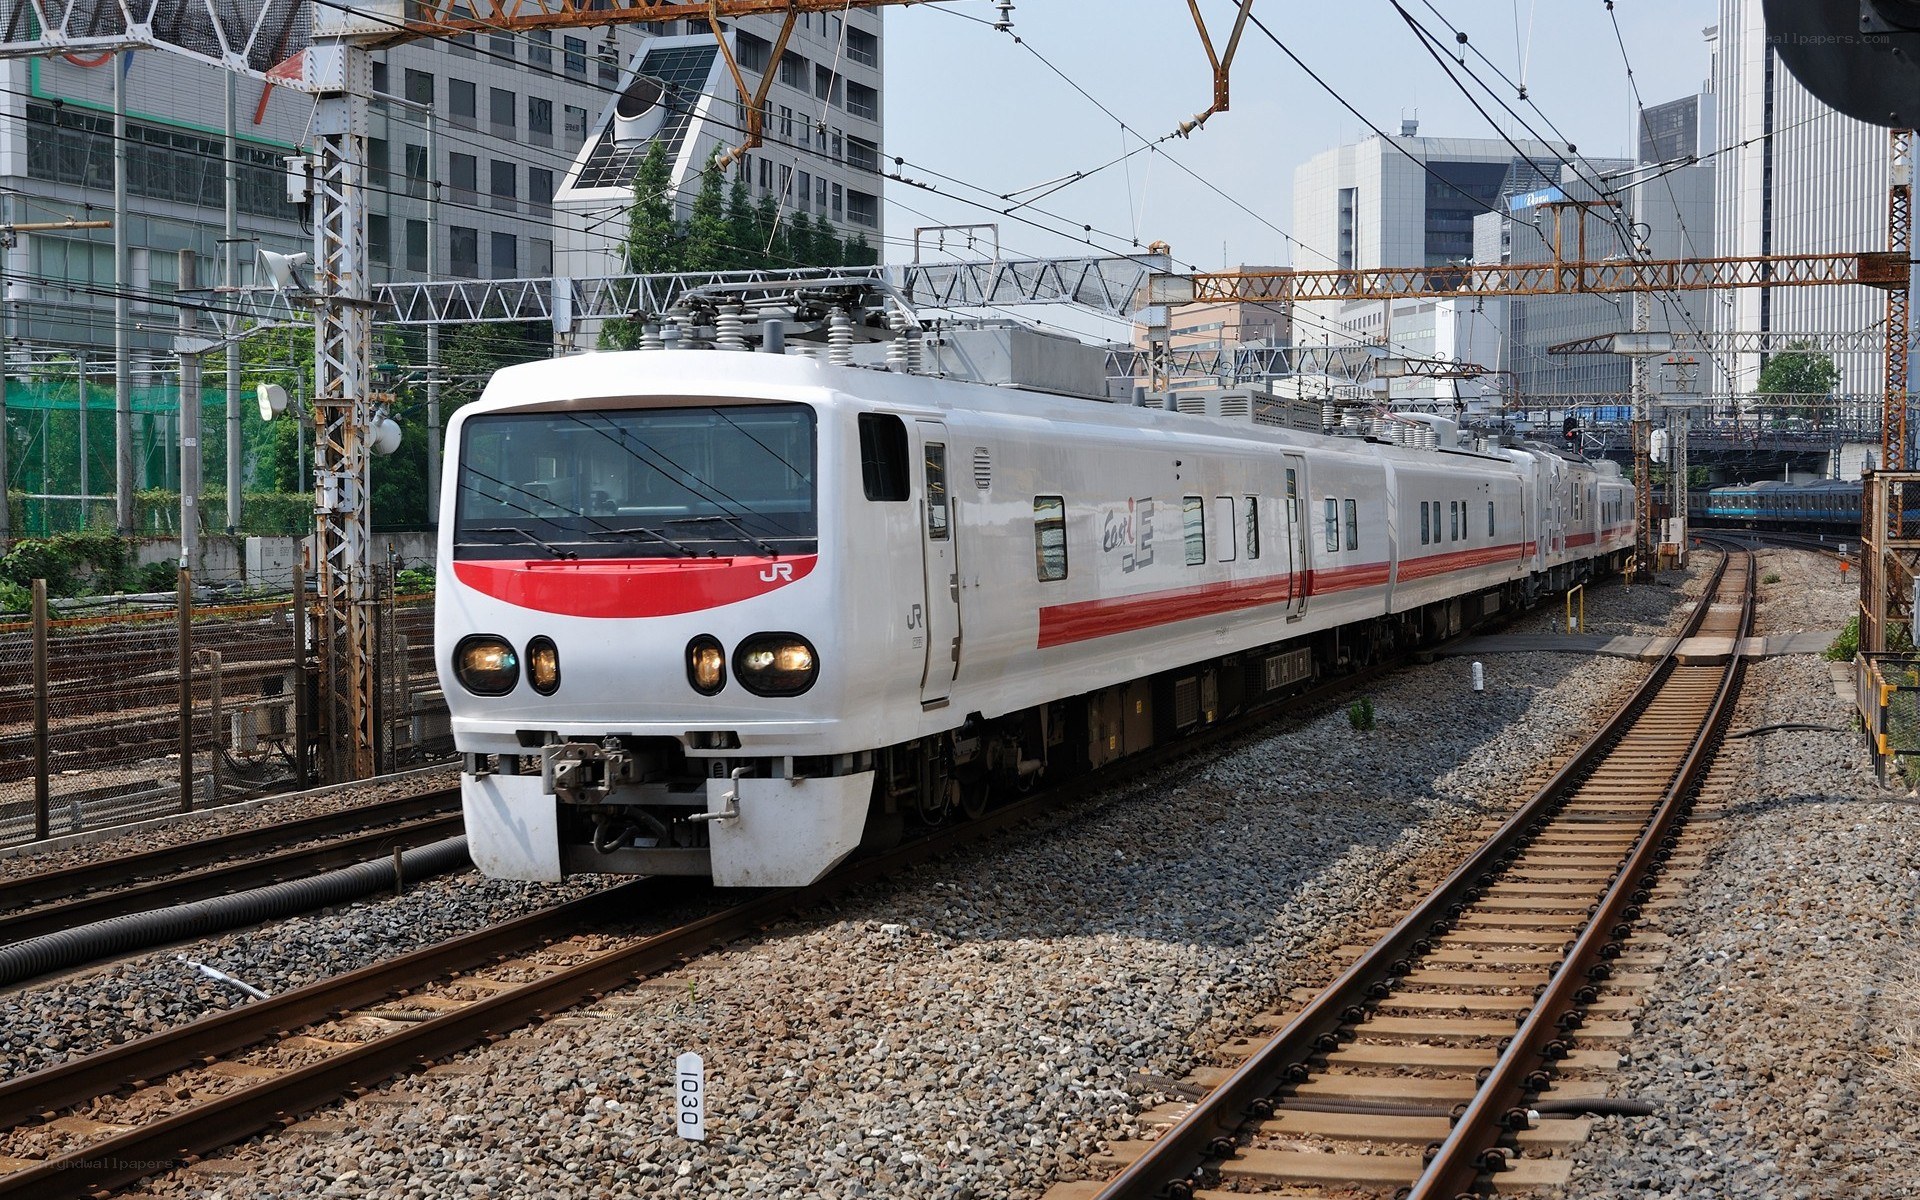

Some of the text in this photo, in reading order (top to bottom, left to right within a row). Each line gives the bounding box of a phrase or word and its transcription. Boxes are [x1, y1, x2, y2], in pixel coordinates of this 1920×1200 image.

[759, 563, 793, 582] JR
[906, 603, 922, 630] JR
[681, 1072, 699, 1125] 1030
